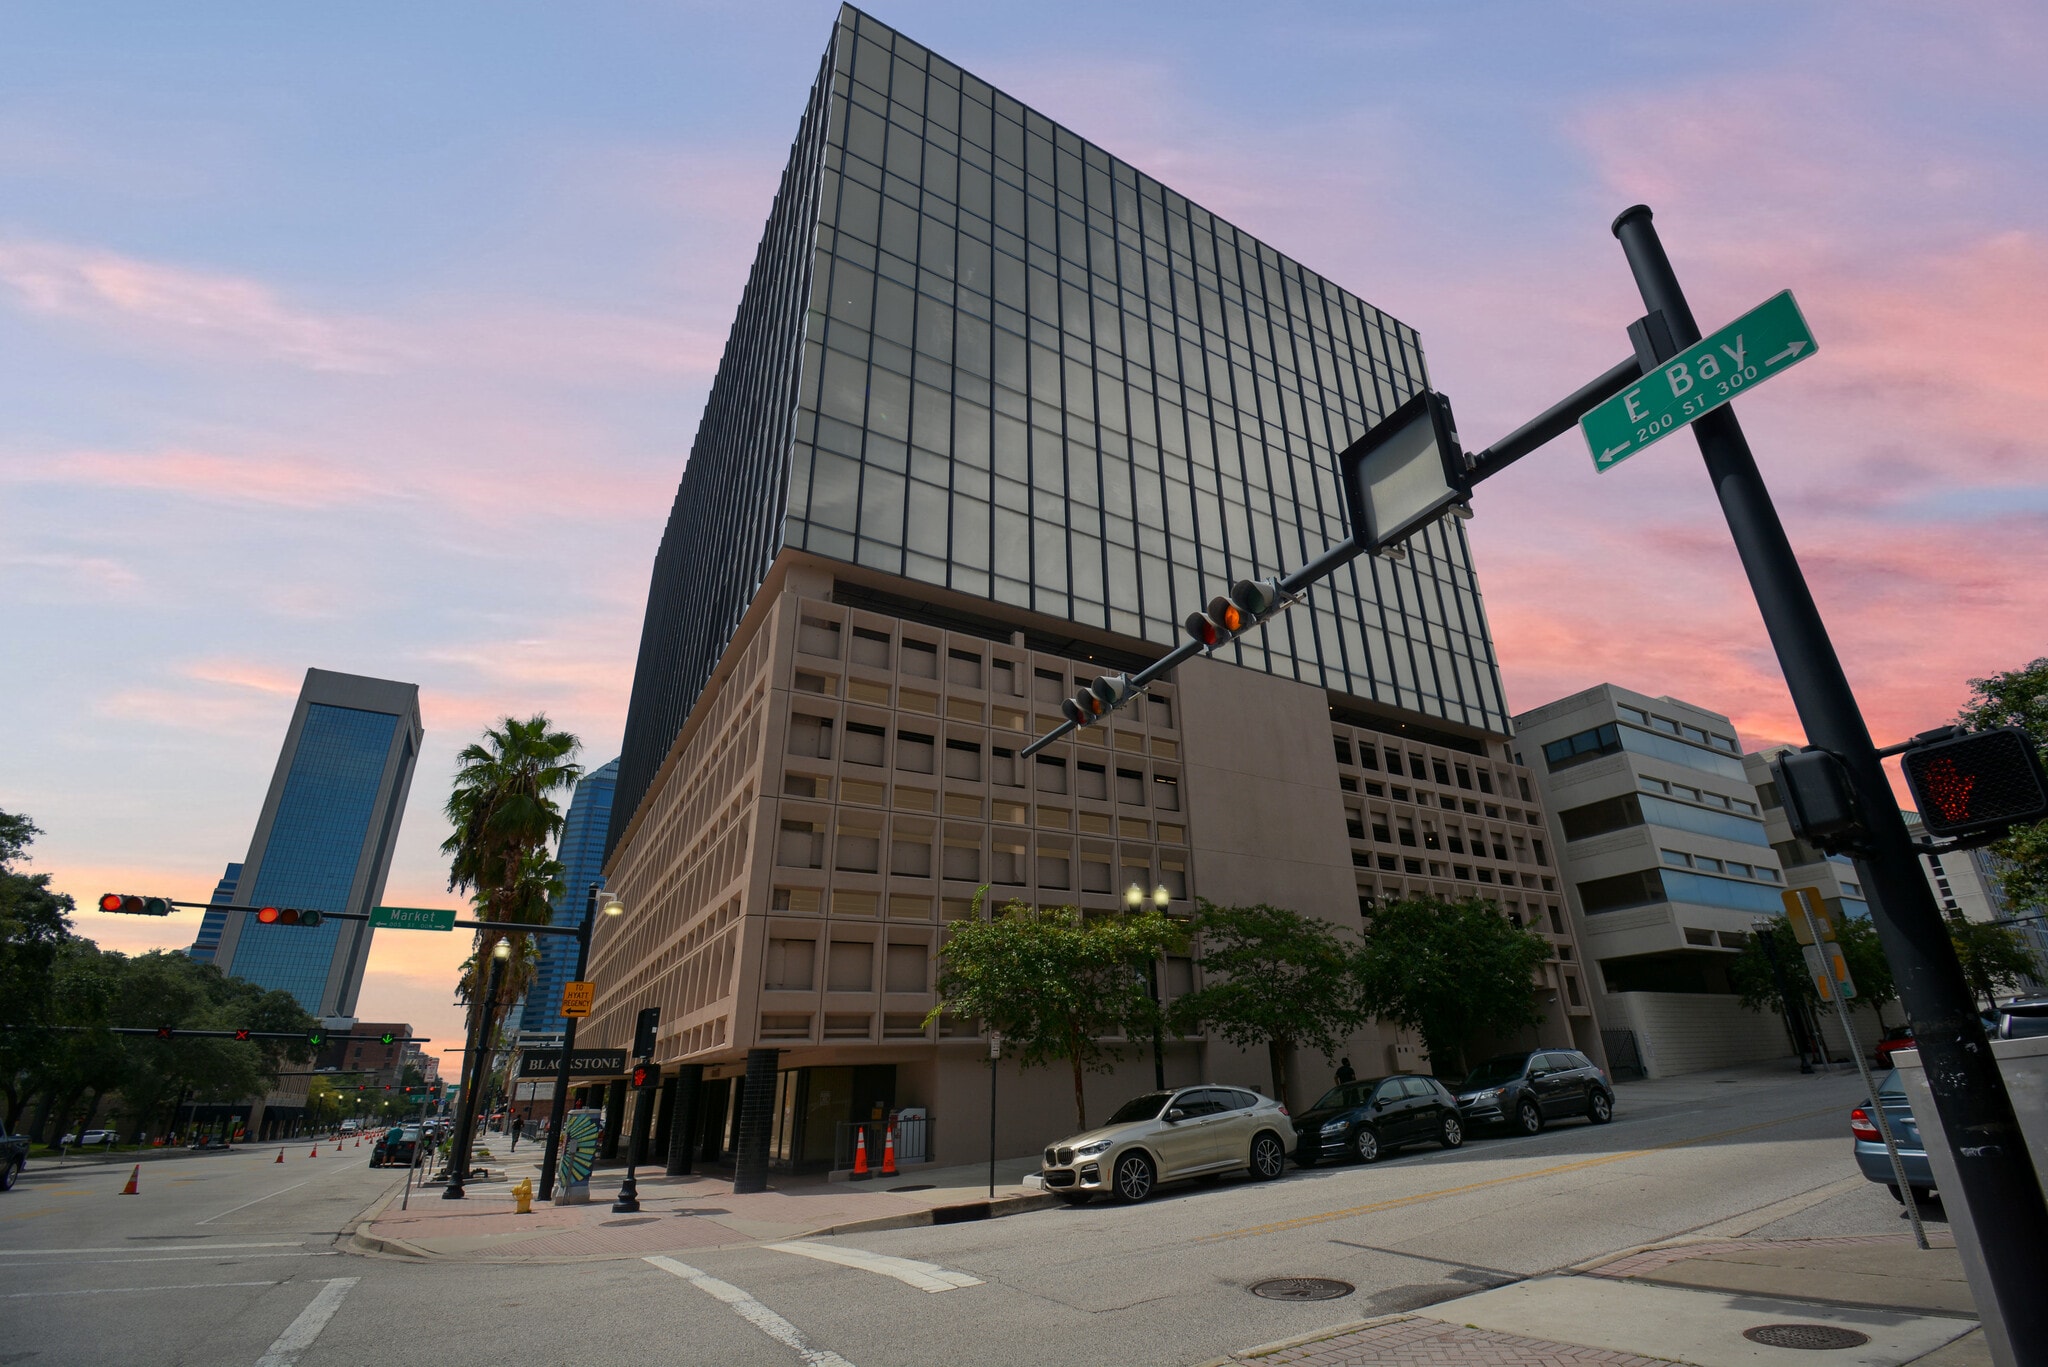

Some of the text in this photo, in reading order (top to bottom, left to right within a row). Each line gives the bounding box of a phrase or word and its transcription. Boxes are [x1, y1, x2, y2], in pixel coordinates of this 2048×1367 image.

[1623, 333, 1744, 424] E Bay
[1636, 365, 1758, 443] 200 ST 300
[391, 910, 436, 922] Market
[528, 1058, 620, 1070] BLACSTONE
